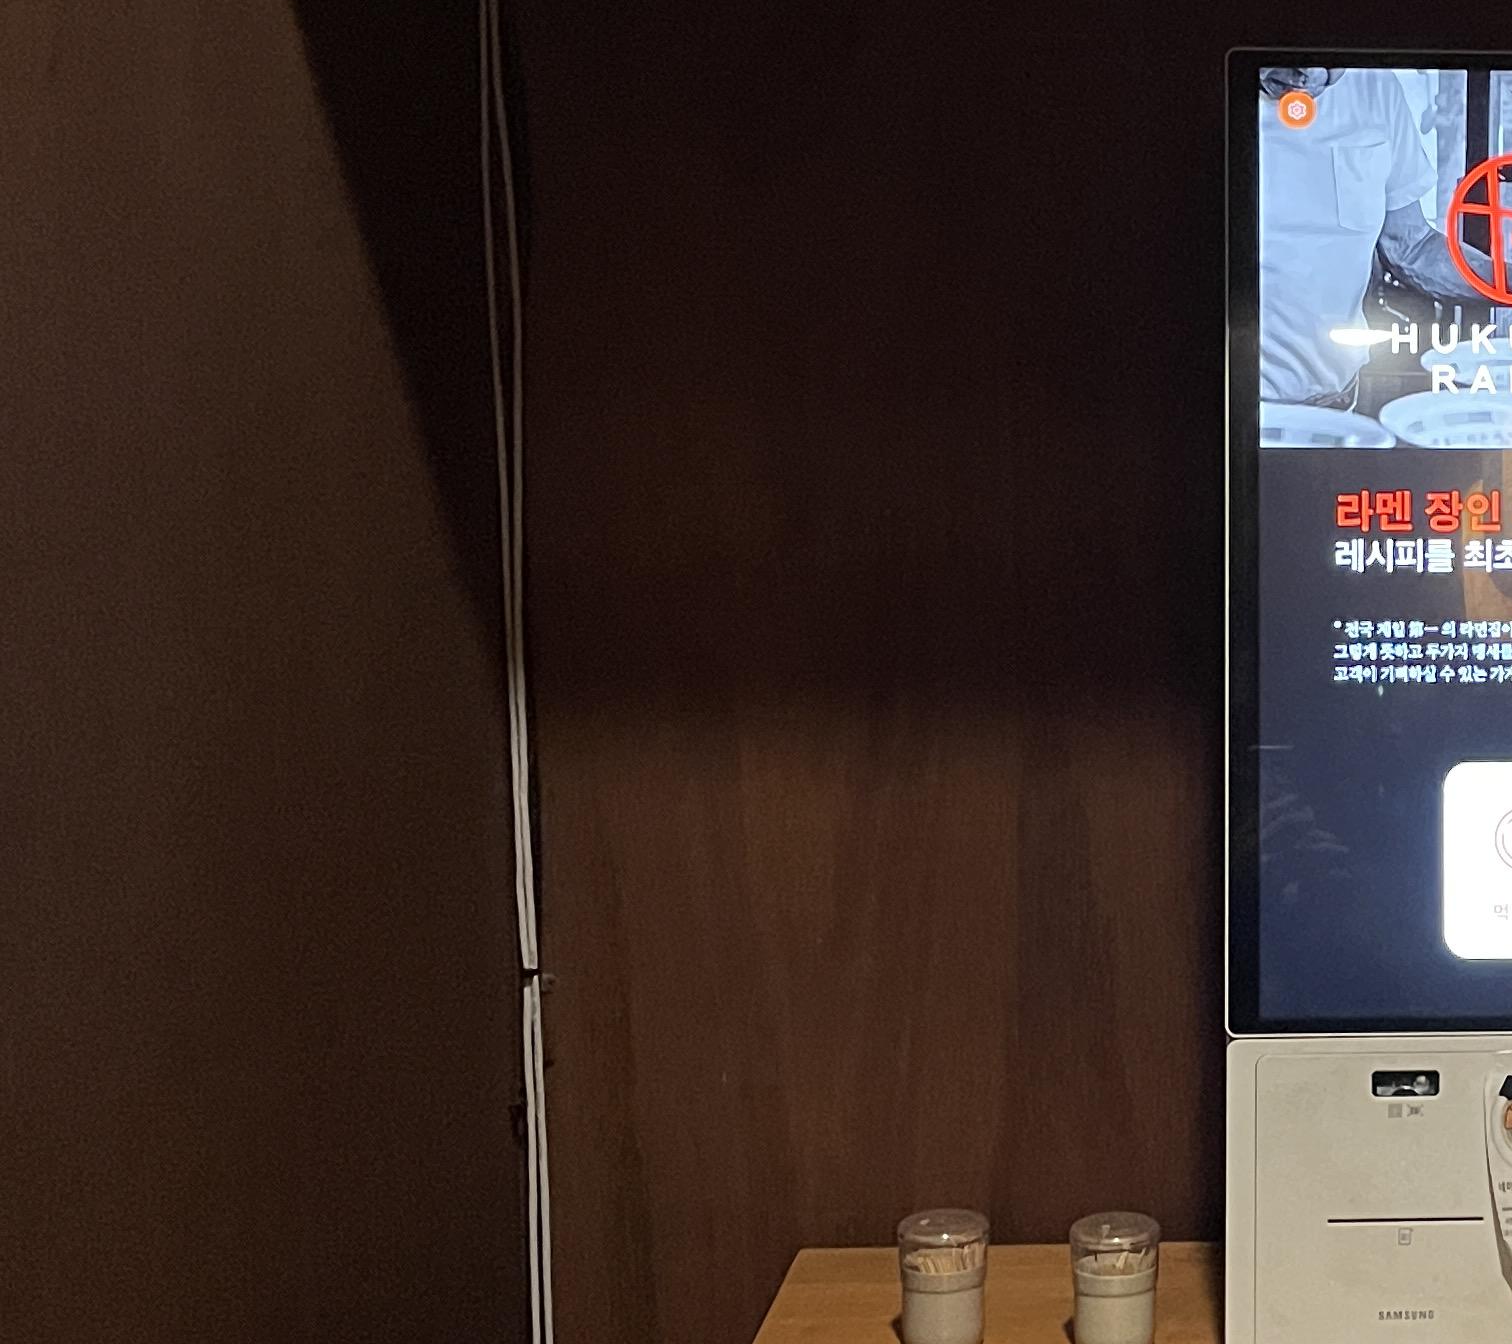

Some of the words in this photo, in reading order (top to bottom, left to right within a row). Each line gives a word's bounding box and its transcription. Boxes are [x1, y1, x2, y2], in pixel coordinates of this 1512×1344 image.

[1336, 489, 1412, 533] 라멘
[1423, 490, 1502, 533] 장인
[1334, 537, 1456, 574] 레시피를
[1439, 664, 1456, 683] 수
[1378, 1310, 1435, 1320] SAMSUNG
